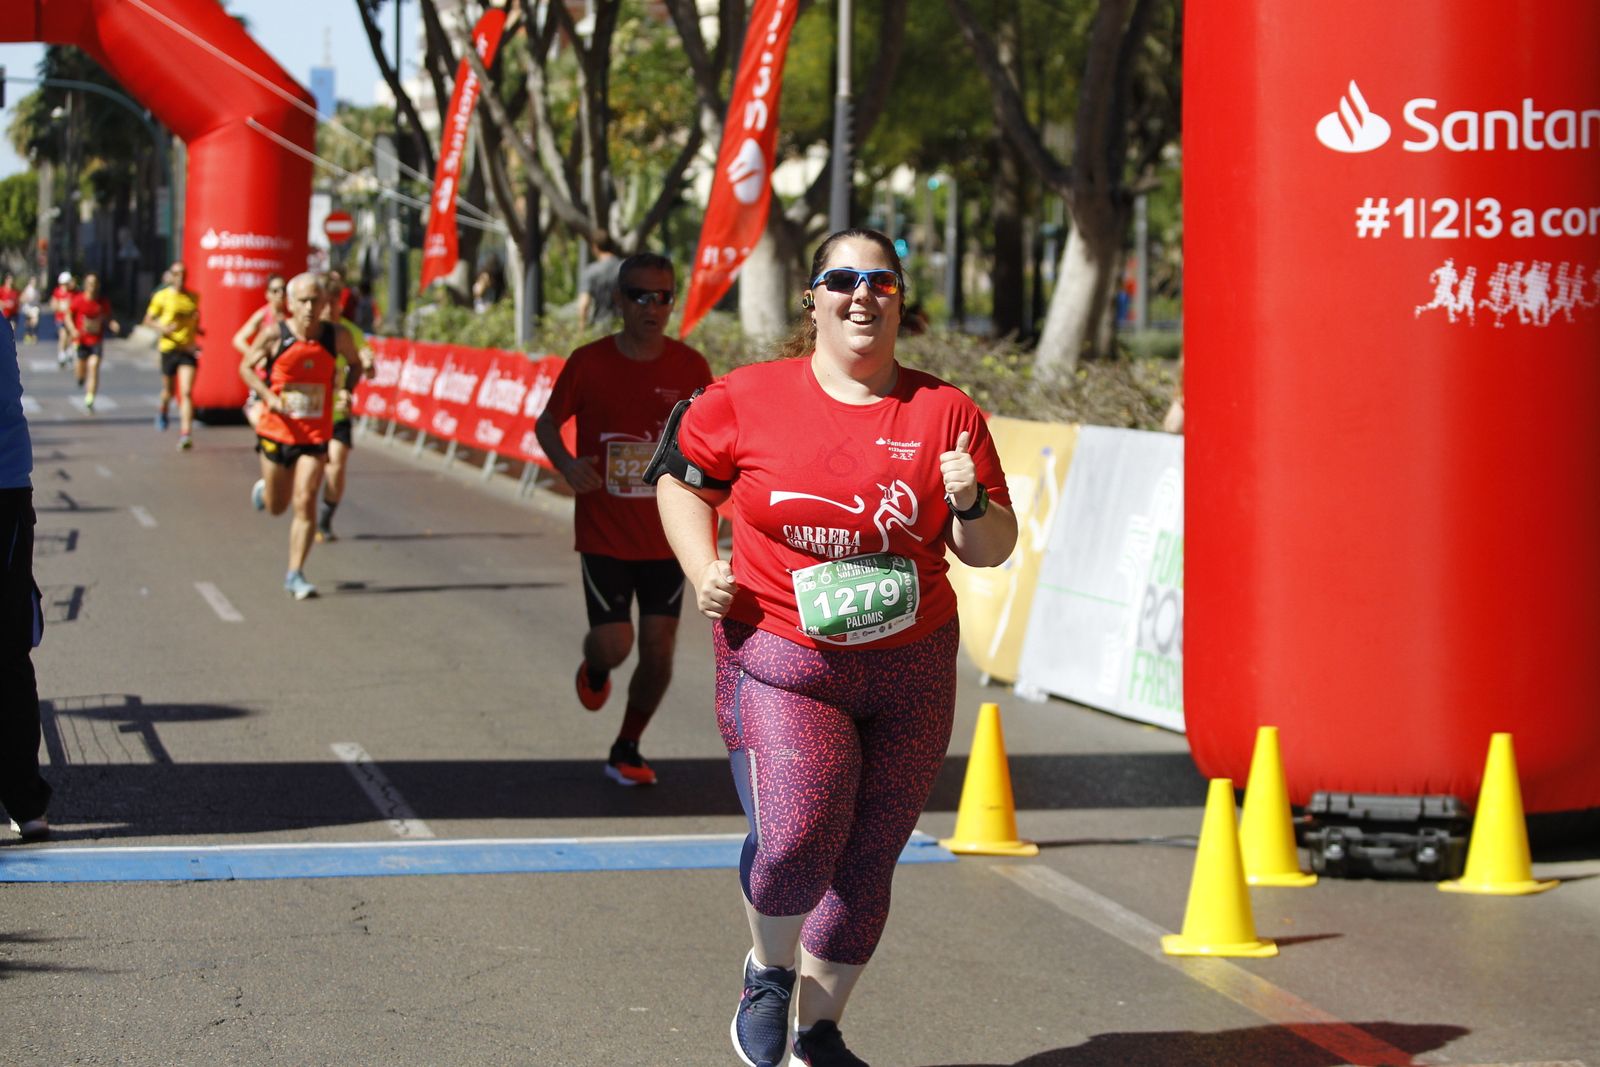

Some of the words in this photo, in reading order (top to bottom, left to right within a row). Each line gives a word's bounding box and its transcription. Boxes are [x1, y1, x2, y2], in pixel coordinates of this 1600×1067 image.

[1510, 208, 1535, 238] a
[886, 438, 922, 448] Santander
[783, 524, 861, 546] CARRERA
[813, 578, 900, 619] 1279
[846, 611, 884, 629] PALOMIS
